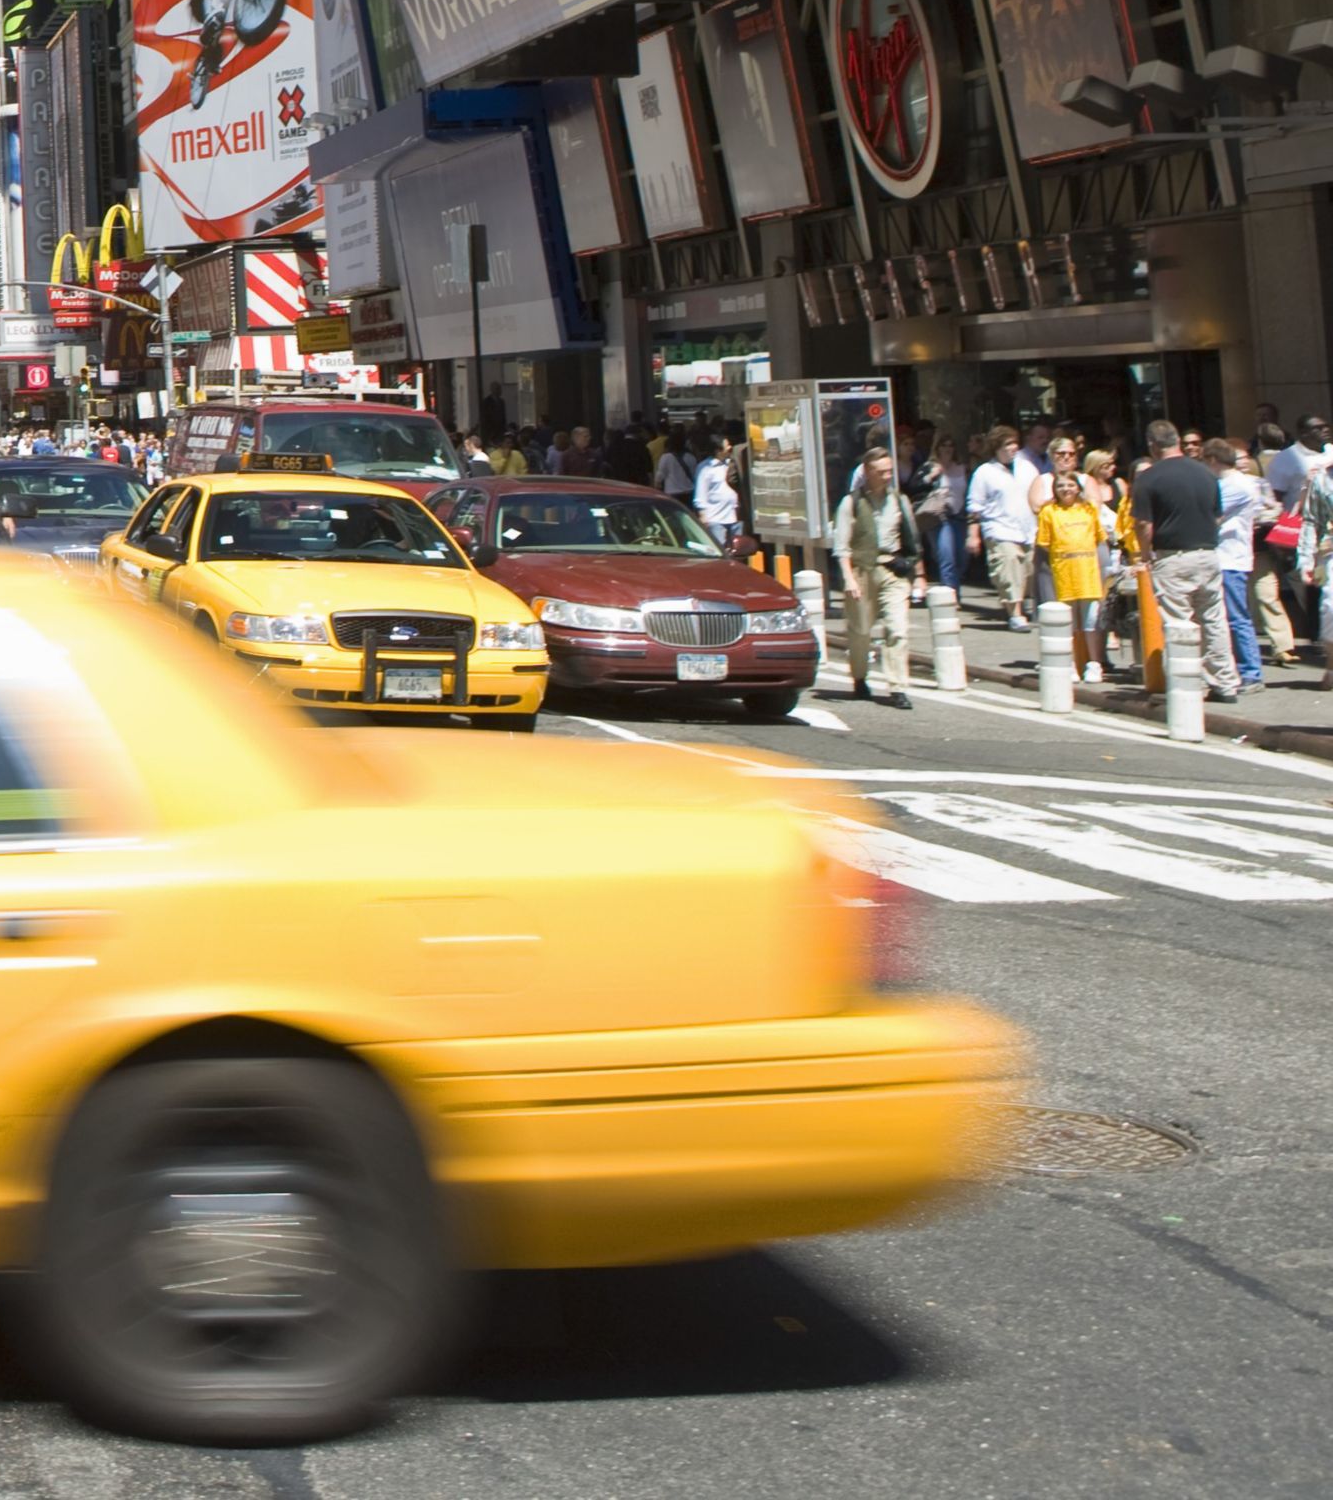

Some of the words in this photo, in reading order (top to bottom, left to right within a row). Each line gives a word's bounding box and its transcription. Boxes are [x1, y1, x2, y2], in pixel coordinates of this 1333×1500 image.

[171, 110, 266, 163] maxell
[278, 128, 308, 140] GAMES
[31, 67, 54, 256] PALACE
[7, 324, 57, 336] LEGALLY
[272, 456, 303, 470] 6G65
